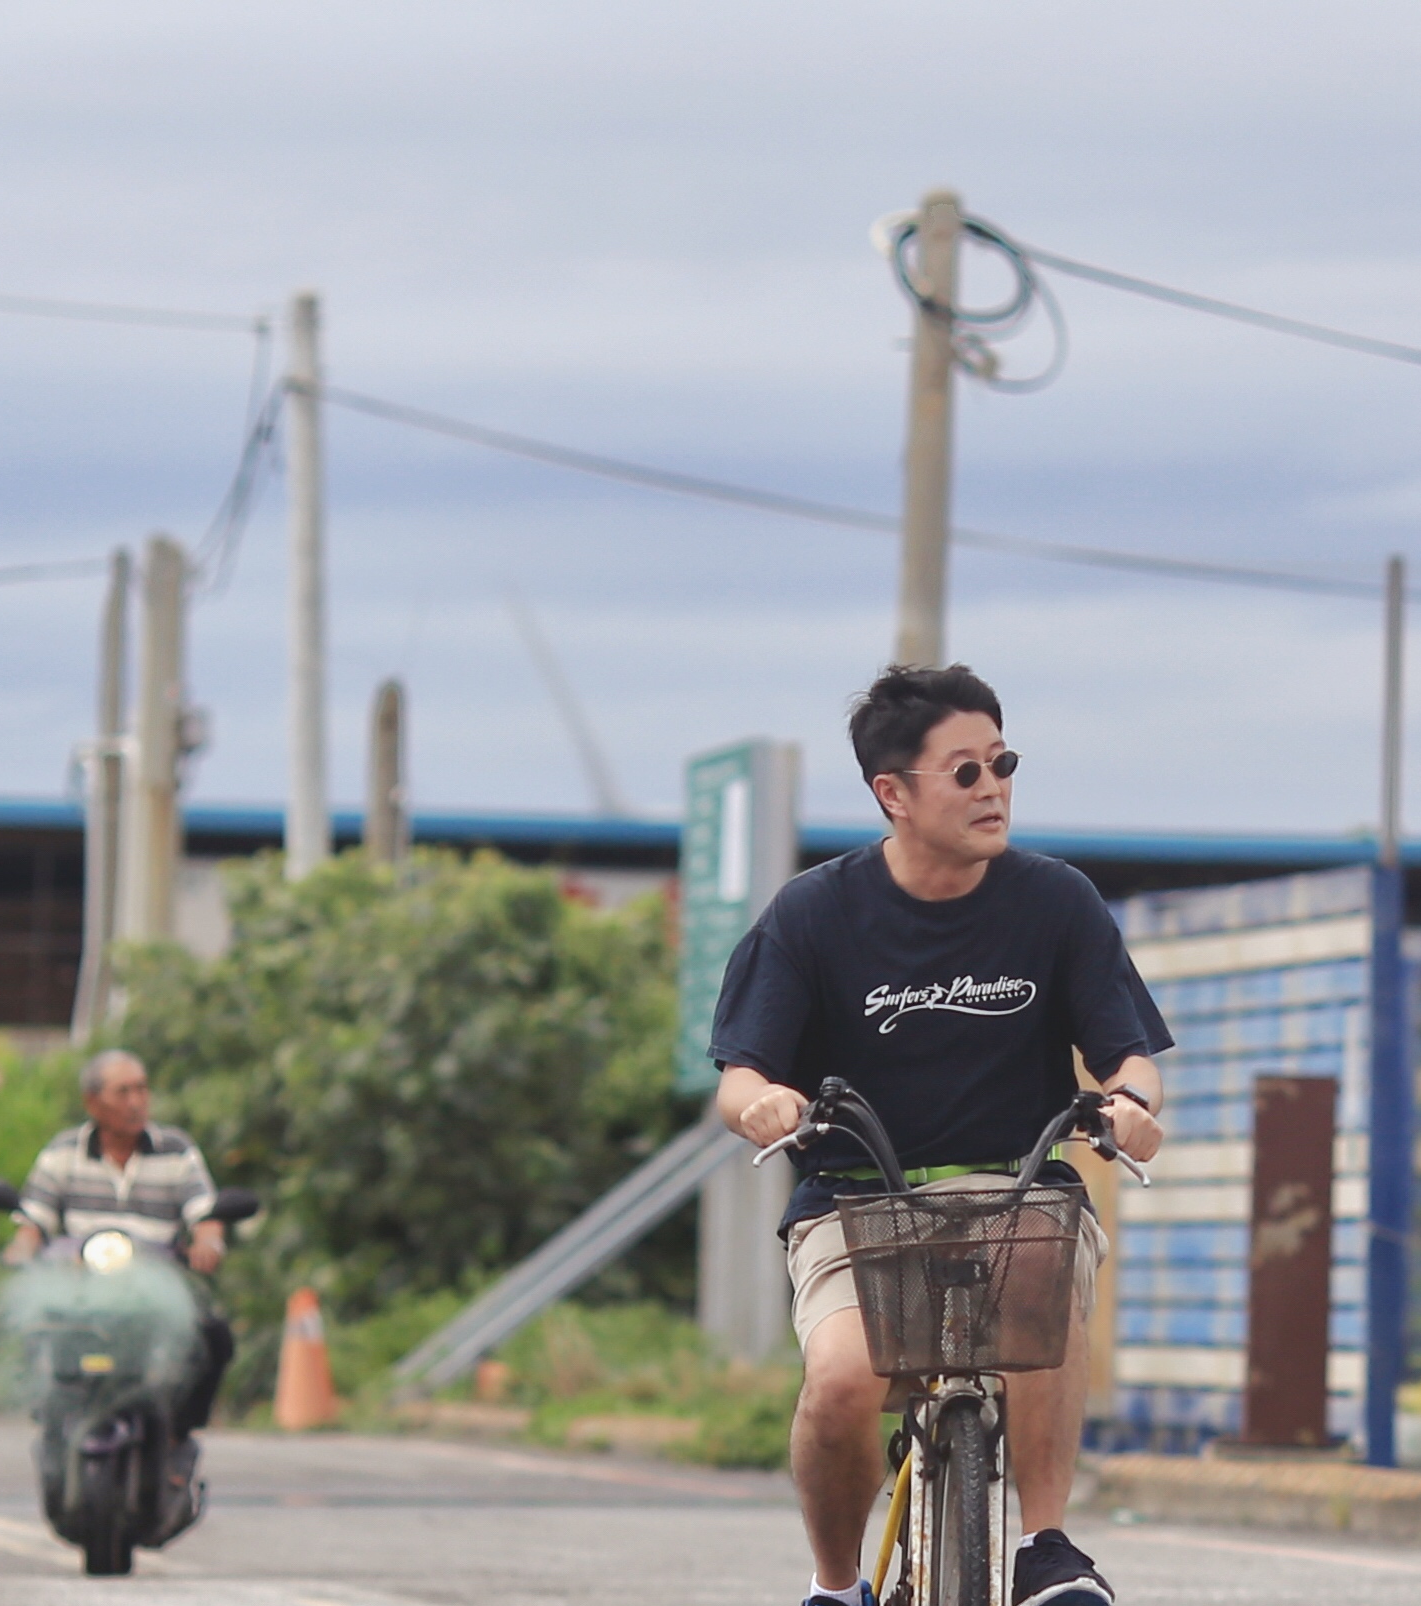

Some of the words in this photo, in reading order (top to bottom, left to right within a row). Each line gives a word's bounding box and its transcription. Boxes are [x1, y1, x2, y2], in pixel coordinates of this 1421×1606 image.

[864, 984, 930, 1016] Surfers
[944, 975, 1024, 1004] Paradise
[956, 990, 1027, 1004] AUSTRALIA
